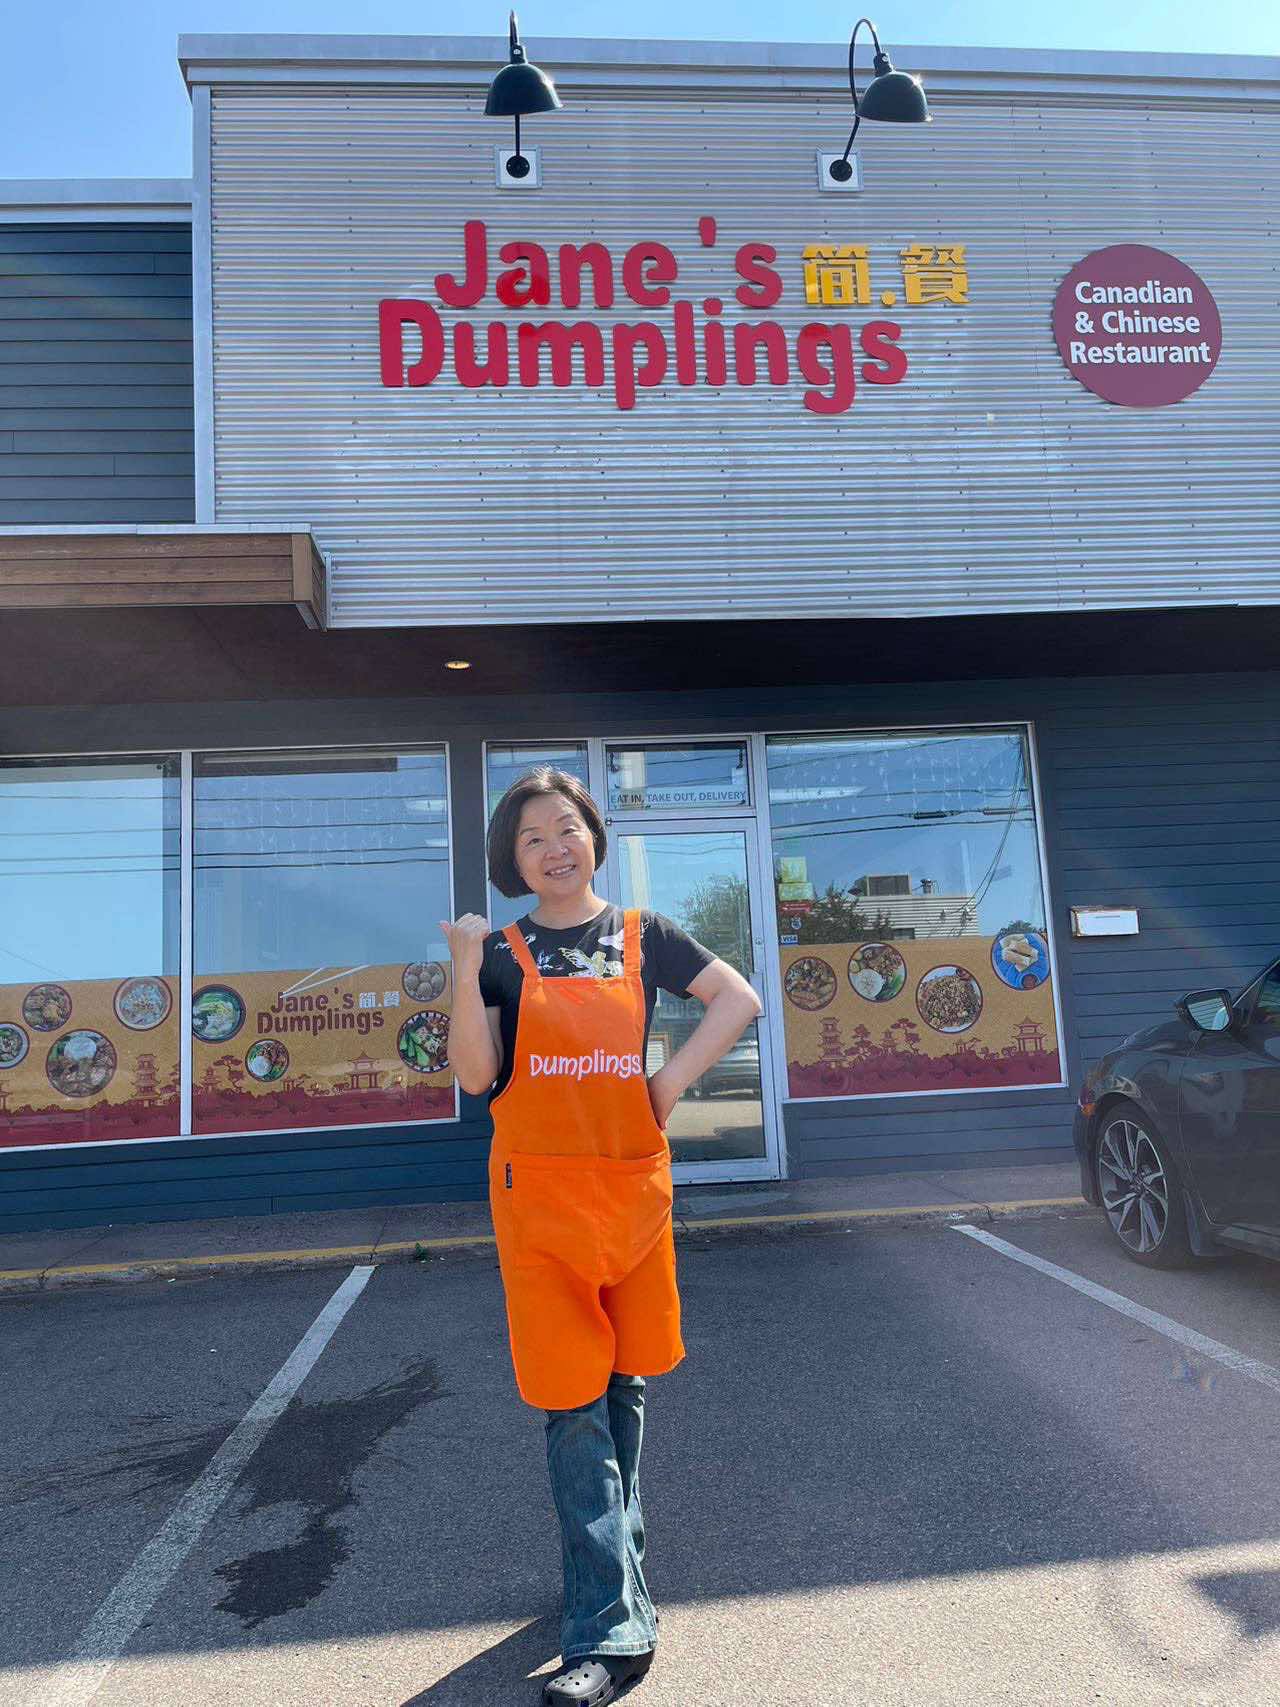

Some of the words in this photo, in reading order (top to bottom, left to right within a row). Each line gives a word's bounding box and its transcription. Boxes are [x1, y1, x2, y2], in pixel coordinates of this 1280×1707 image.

[434, 216, 783, 308] Jane's
[1075, 280, 1193, 304] Canadian
[1075, 311, 1095, 334] &
[1102, 310, 1200, 334] Chinese
[379, 298, 908, 413] Dumplings
[1069, 341, 1212, 364] Restaurant
[610, 792, 630, 804] EAT
[647, 792, 671, 803] TAKE
[699, 790, 747, 801] DELIVERY
[270, 987, 354, 1013] Jane's
[257, 1008, 384, 1036] Dumplings
[529, 1048, 643, 1081] Dumplings
